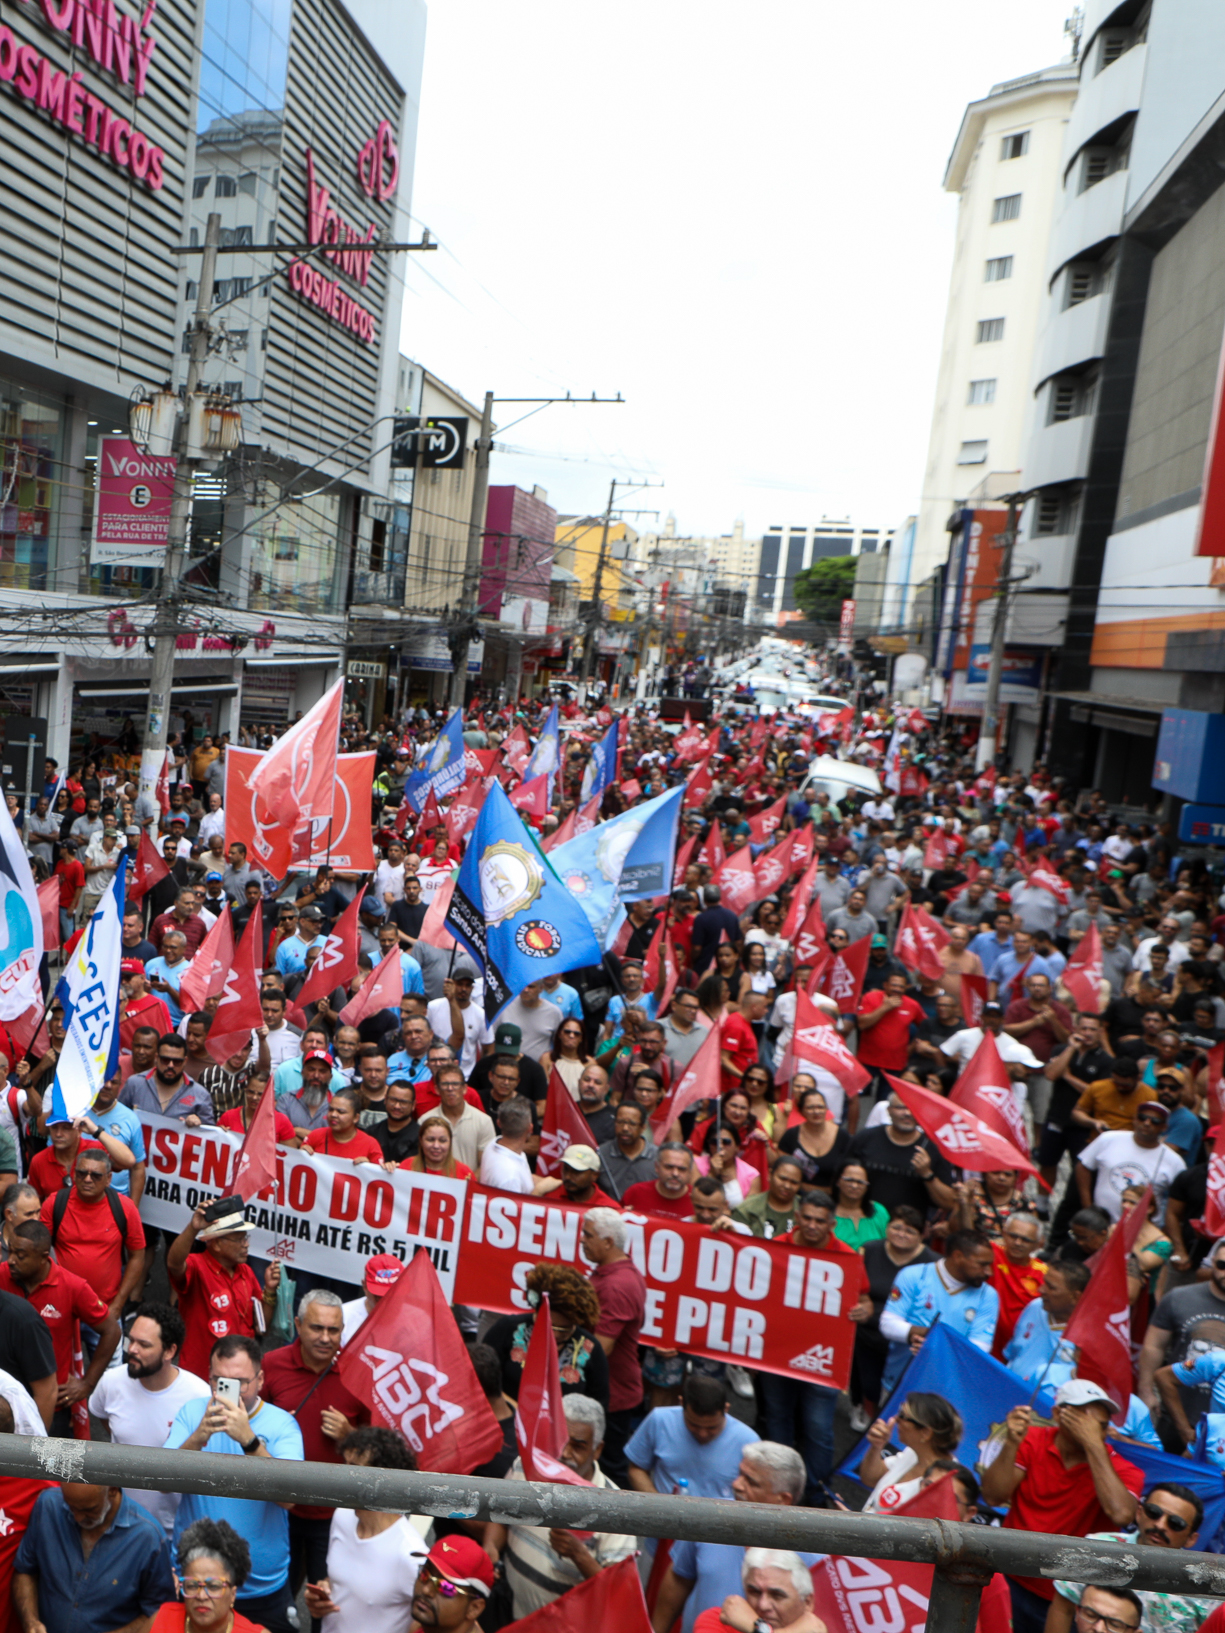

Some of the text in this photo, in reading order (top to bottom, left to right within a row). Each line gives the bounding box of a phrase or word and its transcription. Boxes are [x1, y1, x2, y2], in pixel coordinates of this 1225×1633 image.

[288, 256, 376, 344] COSMÉTICOS
[106, 450, 176, 478] VONNY
[102, 513, 170, 523] ESTACIONAMENT
[102, 522, 169, 533] PARA CLIENTE
[123, 532, 140, 540] RUA
[957, 521, 984, 648] DENTISTA
[450, 907, 473, 937] Santo
[515, 924, 548, 959] SINDICAL
[142, 1125, 457, 1243] ISENÃO DO IR
[244, 1204, 310, 1242] GANHA
[316, 1225, 352, 1252] ATÉ
[357, 1232, 387, 1257] R$
[393, 1239, 407, 1262] 5
[695, 1237, 773, 1301] DO
[783, 1254, 845, 1318] IR
[214, 1294, 230, 1308] 13
[211, 1320, 227, 1333] 13
[675, 1295, 767, 1360] PLR
